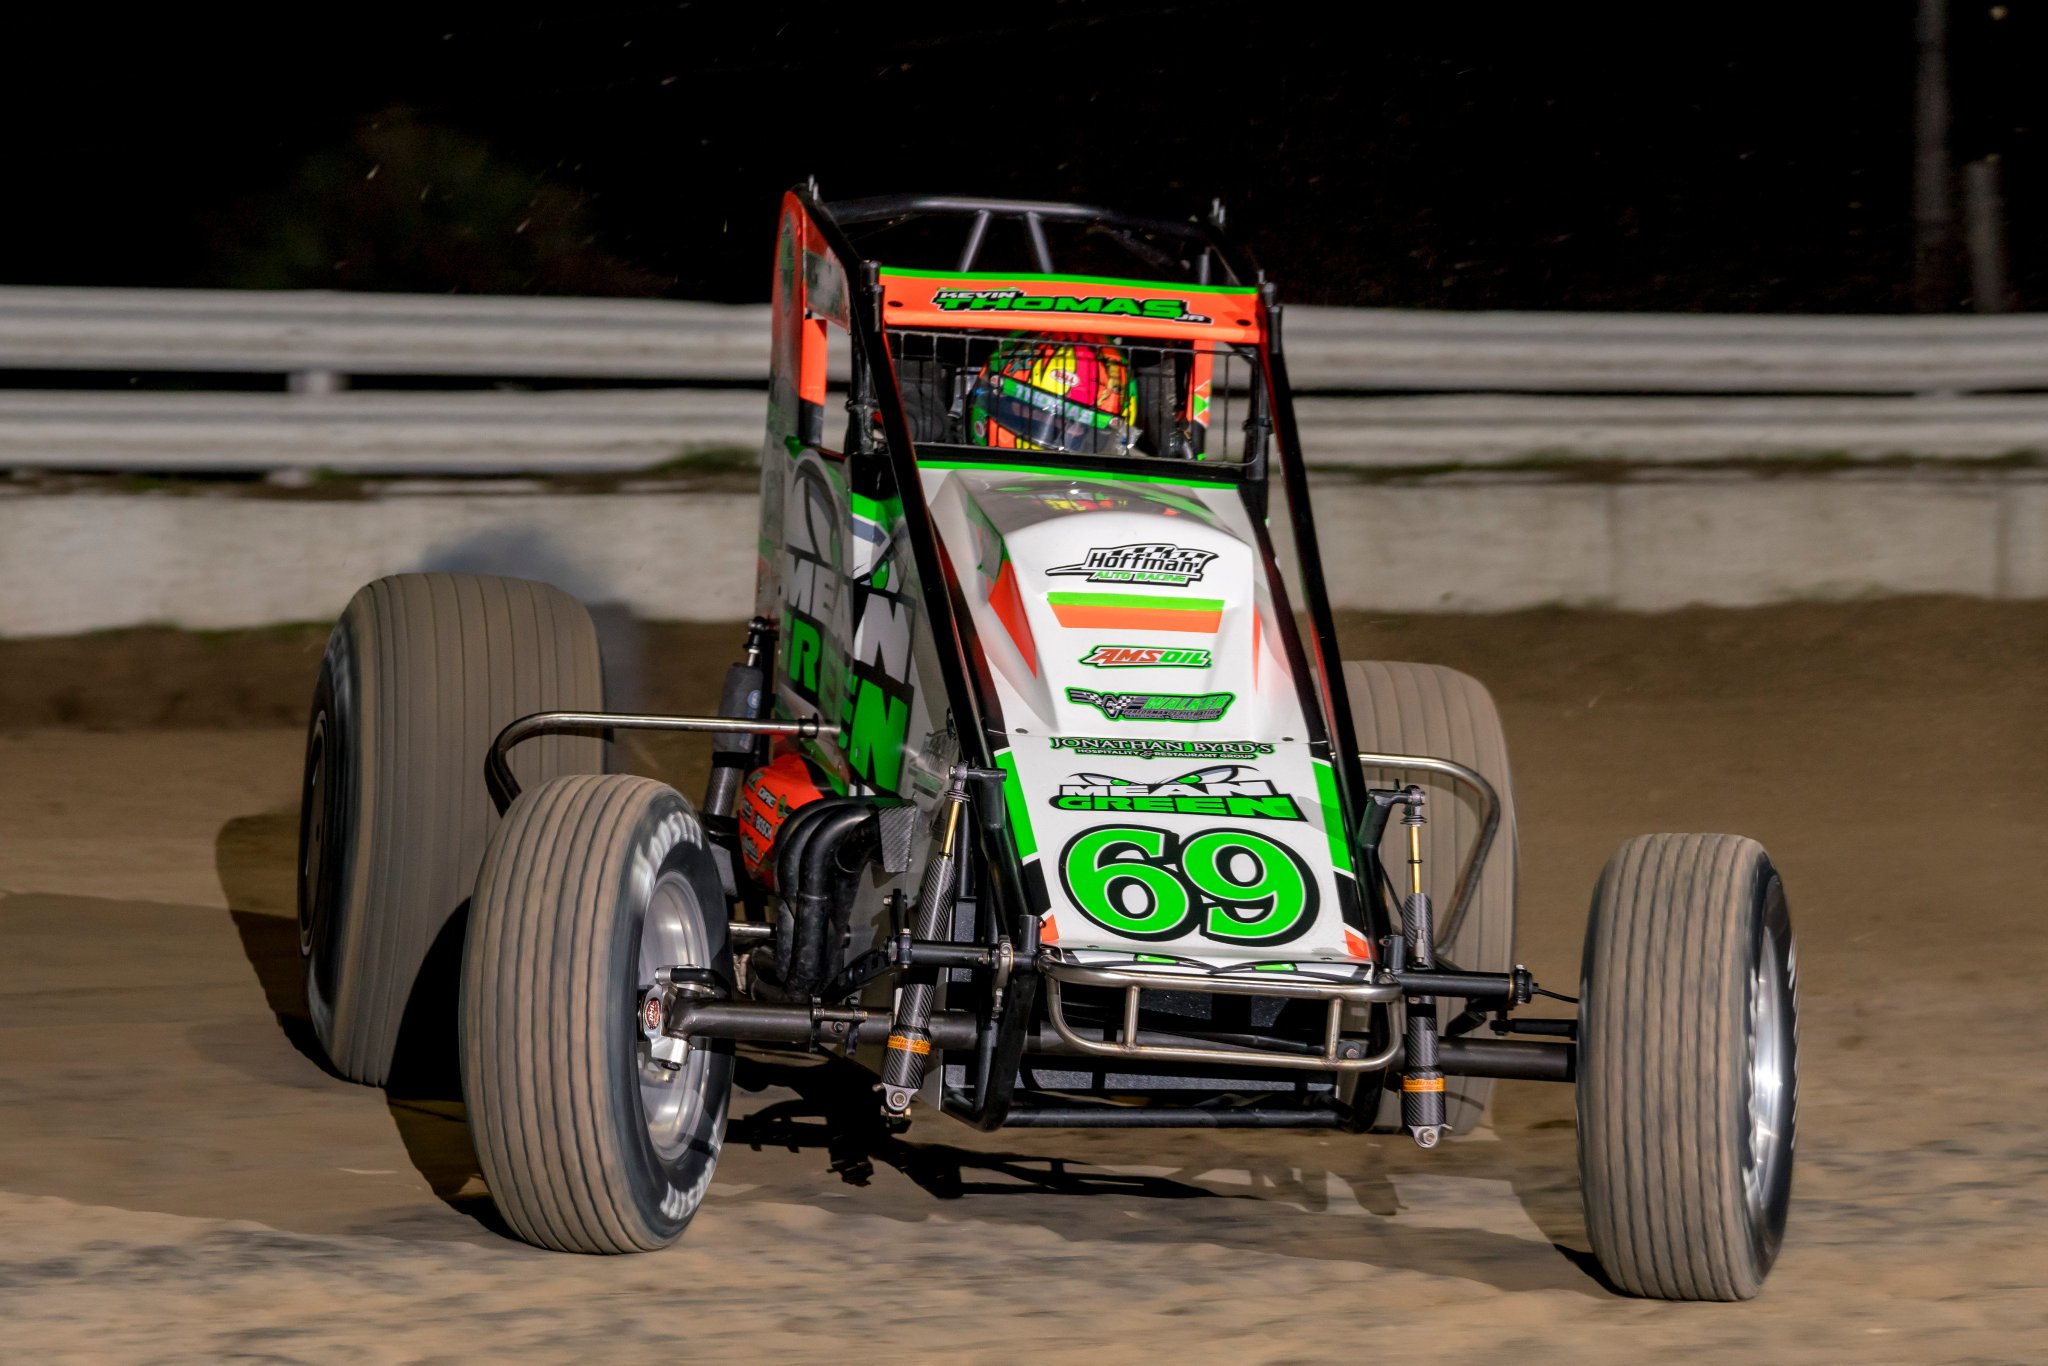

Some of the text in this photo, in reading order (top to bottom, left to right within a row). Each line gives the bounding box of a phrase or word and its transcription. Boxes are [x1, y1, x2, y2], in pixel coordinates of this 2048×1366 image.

[939, 291, 1017, 299] KEVIN
[937, 296, 1184, 319] THOMAS
[1087, 552, 1196, 573] Hoffman
[1094, 571, 1187, 583] AUTO RACING
[1089, 648, 1206, 665] AMSOIL
[1143, 695, 1232, 711] WALKER
[1052, 738, 1273, 754] JONATHAN BYRD'S
[1076, 748, 1139, 756] HOSPITALITY
[1154, 751, 1218, 759] RESTAURANT
[1060, 779, 1278, 797] MEAN
[1055, 795, 1301, 820] GREEN
[1061, 825, 1317, 944] 69
